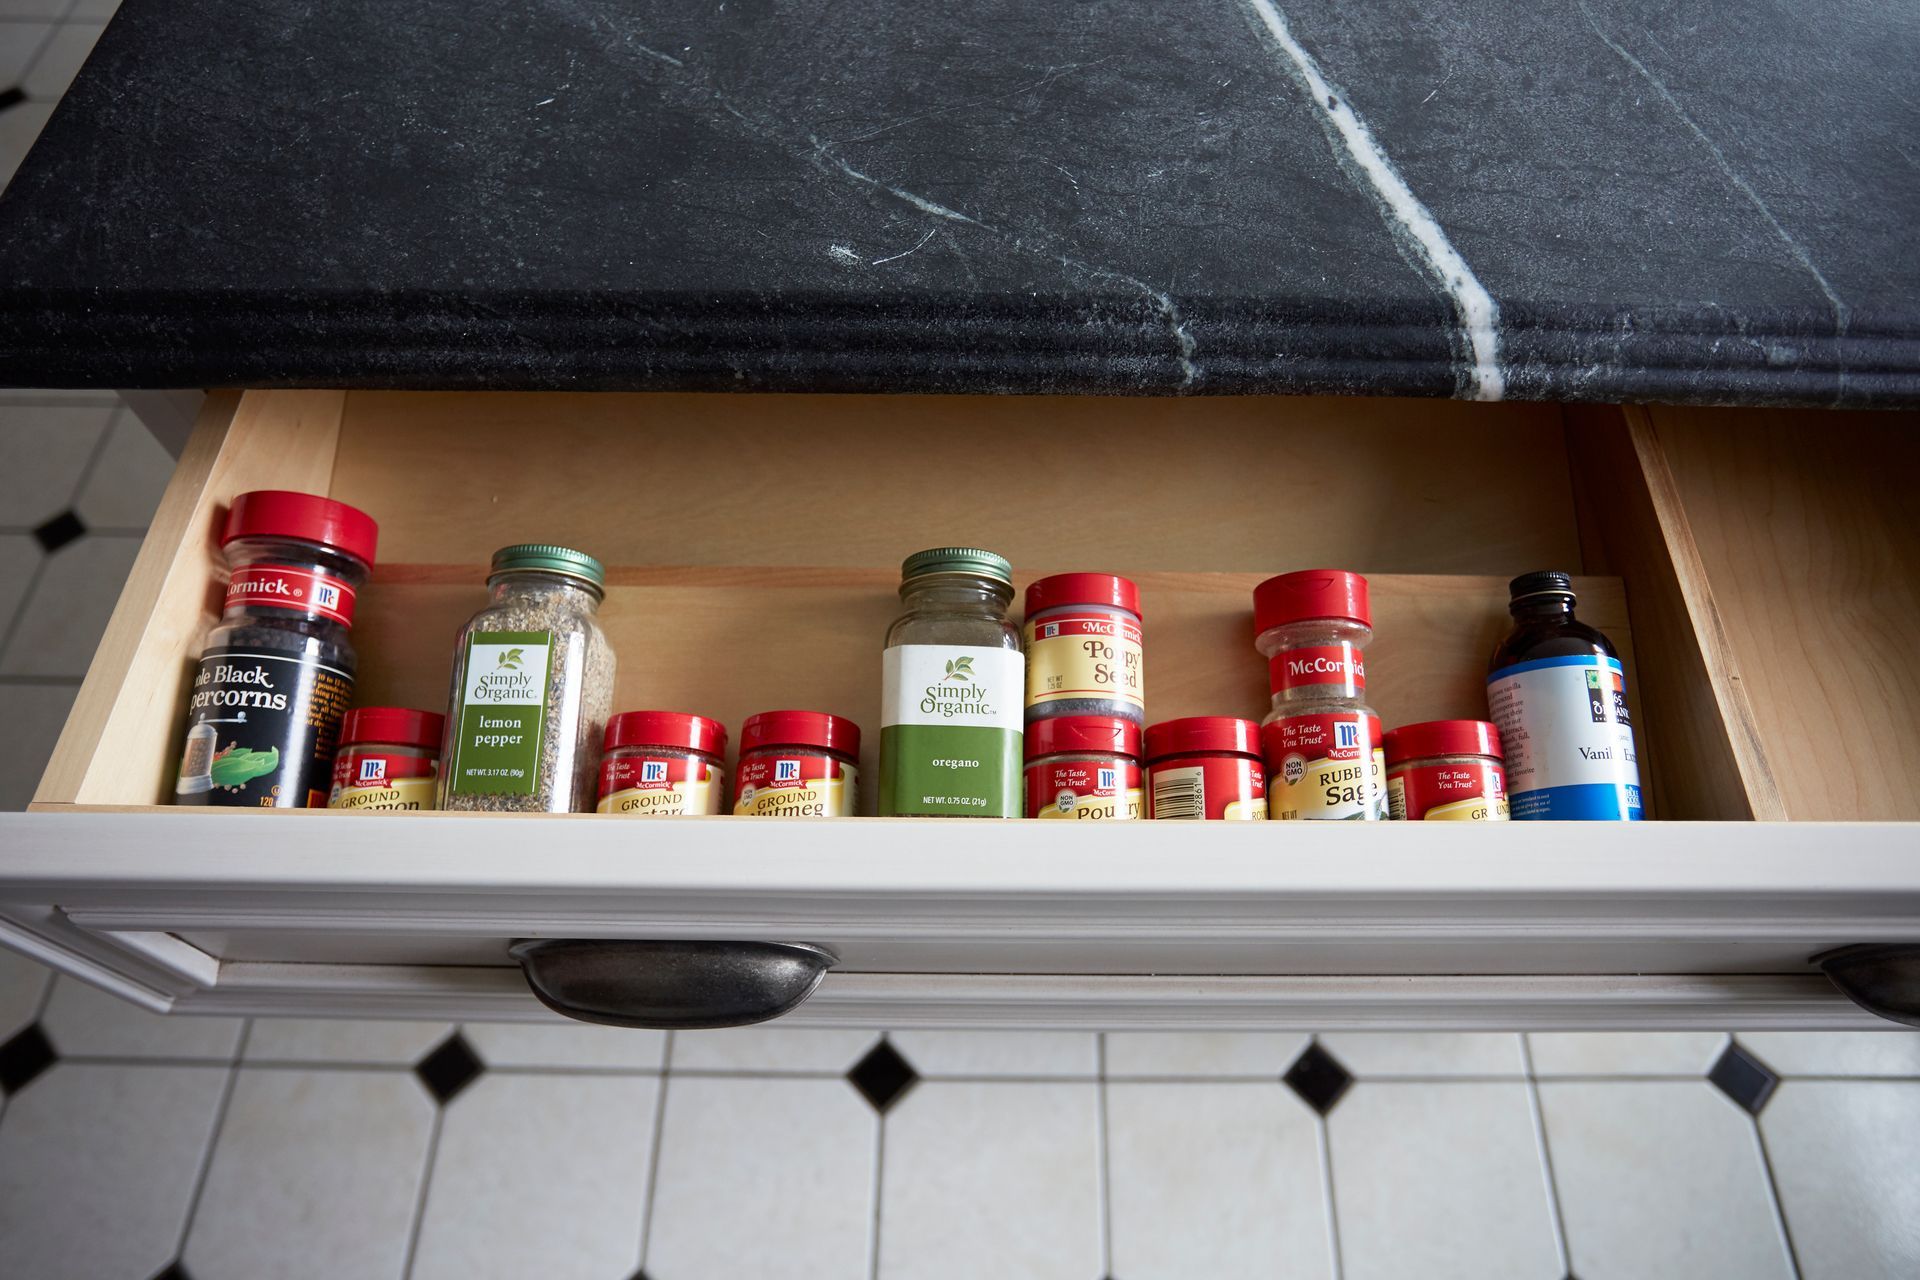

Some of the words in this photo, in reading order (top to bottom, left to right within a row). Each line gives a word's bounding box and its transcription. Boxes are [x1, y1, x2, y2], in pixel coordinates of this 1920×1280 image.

[1082, 621, 1141, 642] McCmick
[1083, 640, 1141, 670] Popy
[214, 665, 274, 689] Black
[479, 672, 532, 689] Simply
[474, 685, 535, 702] Organic
[926, 683, 987, 702] Simply
[190, 689, 287, 714] percorns
[920, 698, 990, 717] Organic
[479, 715, 522, 729] lemon
[1282, 727, 1297, 737] The
[1298, 724, 1322, 734] Taste
[474, 733, 523, 747] pepper
[1282, 739, 1297, 748] You
[1299, 735, 1323, 746] Trust
[1579, 746, 1613, 760] Vanil
[616, 762, 630, 770] Taste
[752, 763, 766, 771] Taste
[932, 758, 980, 769] oregano
[1286, 761, 1302, 769] NON
[466, 768, 477, 776] NET
[488, 768, 499, 777] 3.17
[510, 769, 524, 778] (90g)
[615, 771, 631, 780] Trust
[750, 772, 765, 781] Trust
[1056, 769, 1067, 778] The
[1068, 769, 1087, 777] Taste
[1285, 767, 1303, 776] GMO
[1319, 764, 1379, 786] RUBBD
[1438, 772, 1451, 780] The
[1452, 771, 1471, 779] Taste
[355, 779, 388, 788] McCormick
[636, 781, 671, 789] McCormick
[770, 780, 803, 788] McCormick
[1068, 778, 1087, 787] Trust
[1454, 780, 1473, 789] Trust
[341, 790, 400, 809] GROUND
[621, 794, 682, 811] GROUND
[757, 791, 817, 810] GROUND
[923, 796, 935, 804] NET
[935, 796, 947, 804] WT.
[947, 796, 961, 805] 0.75
[972, 797, 987, 808] (21g)
[1077, 802, 1141, 819] Poury
